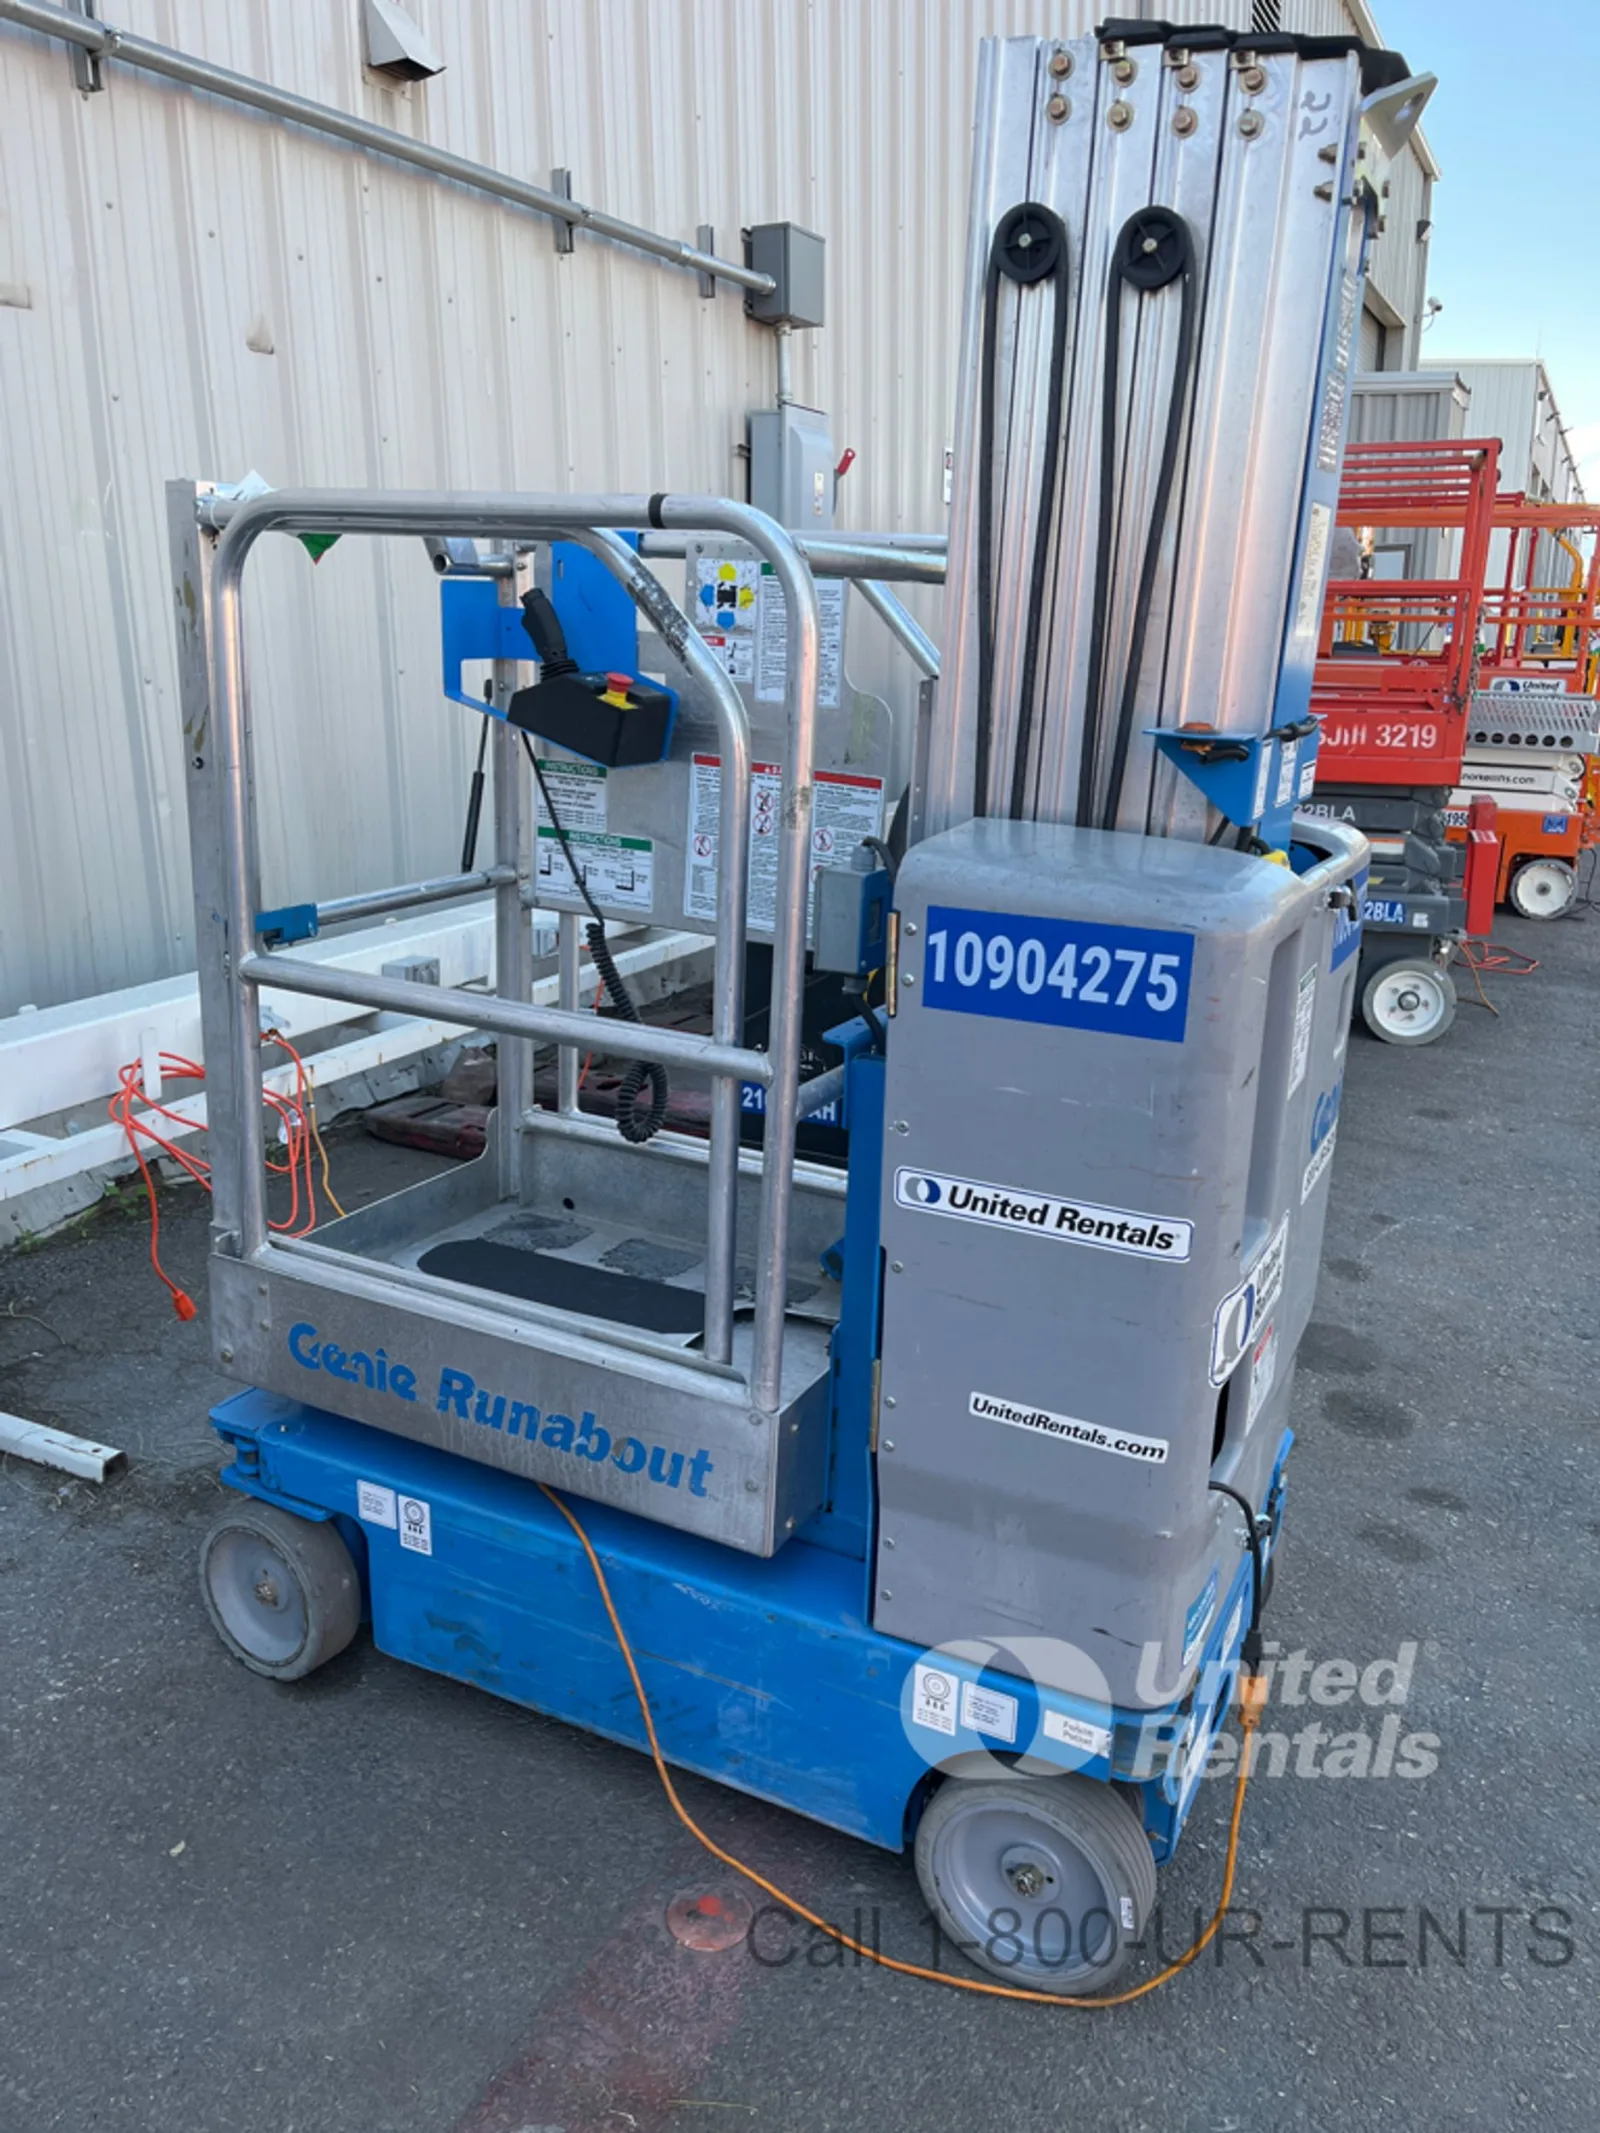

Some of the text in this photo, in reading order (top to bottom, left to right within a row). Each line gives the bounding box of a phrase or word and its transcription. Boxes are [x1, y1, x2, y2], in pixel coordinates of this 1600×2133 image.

[1374, 723, 1438, 749] 3219
[927, 929, 1180, 1012] 10904275
[948, 1185, 1174, 1251] United Rentals
[287, 1322, 716, 1497] Genie Runabout
[971, 1397, 1166, 1460] UnitedRentals.com
